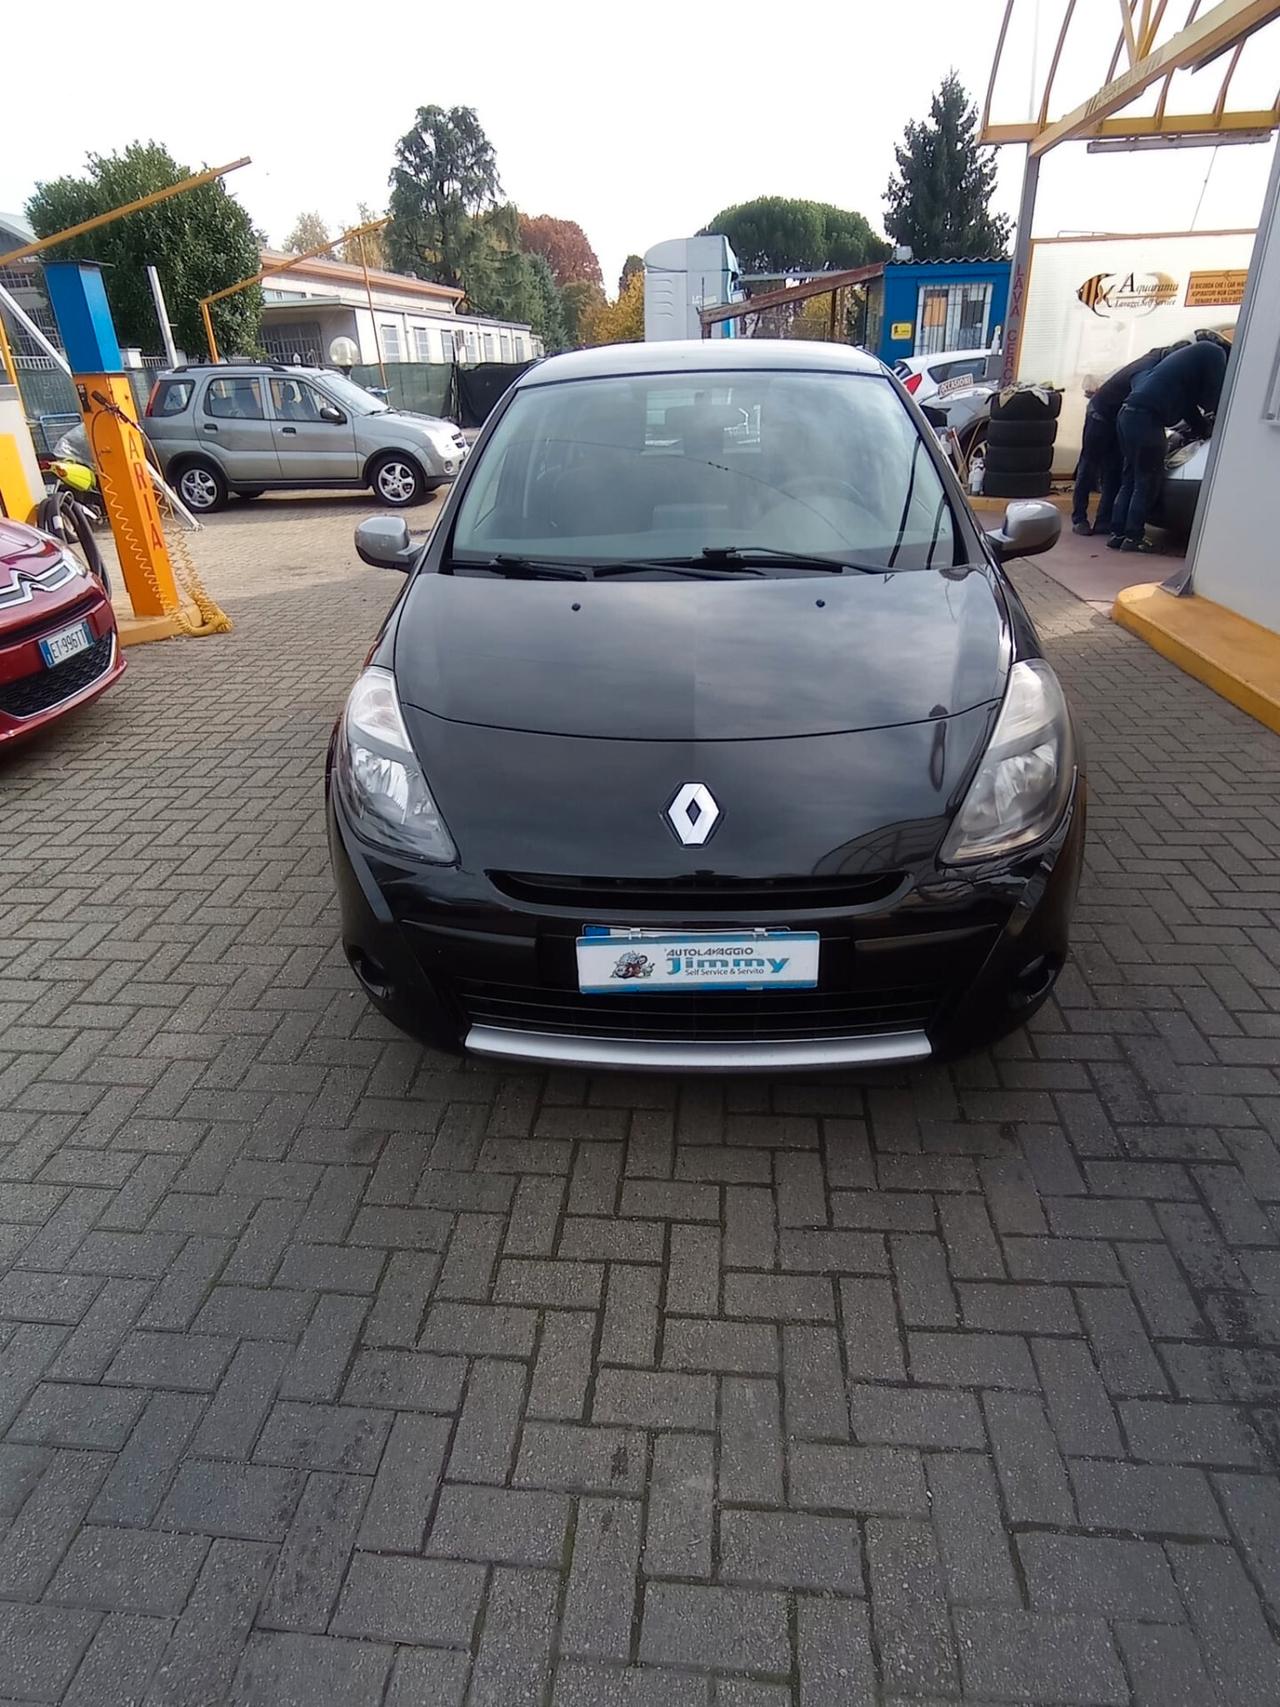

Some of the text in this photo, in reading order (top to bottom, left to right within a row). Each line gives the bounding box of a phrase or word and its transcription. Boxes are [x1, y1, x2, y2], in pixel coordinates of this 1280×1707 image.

[1009, 264, 1024, 317] LAVA
[1118, 272, 1179, 294] Aquarama
[941, 375, 971, 396] OCCASIONI
[128, 430, 163, 550] ARIA
[50, 629, 86, 659] ET 996TT
[666, 947, 754, 957] AUTOLAVAGGIO
[666, 957, 790, 975] Jimmy
[685, 968, 699, 976] Self
[701, 968, 728, 976] Service
